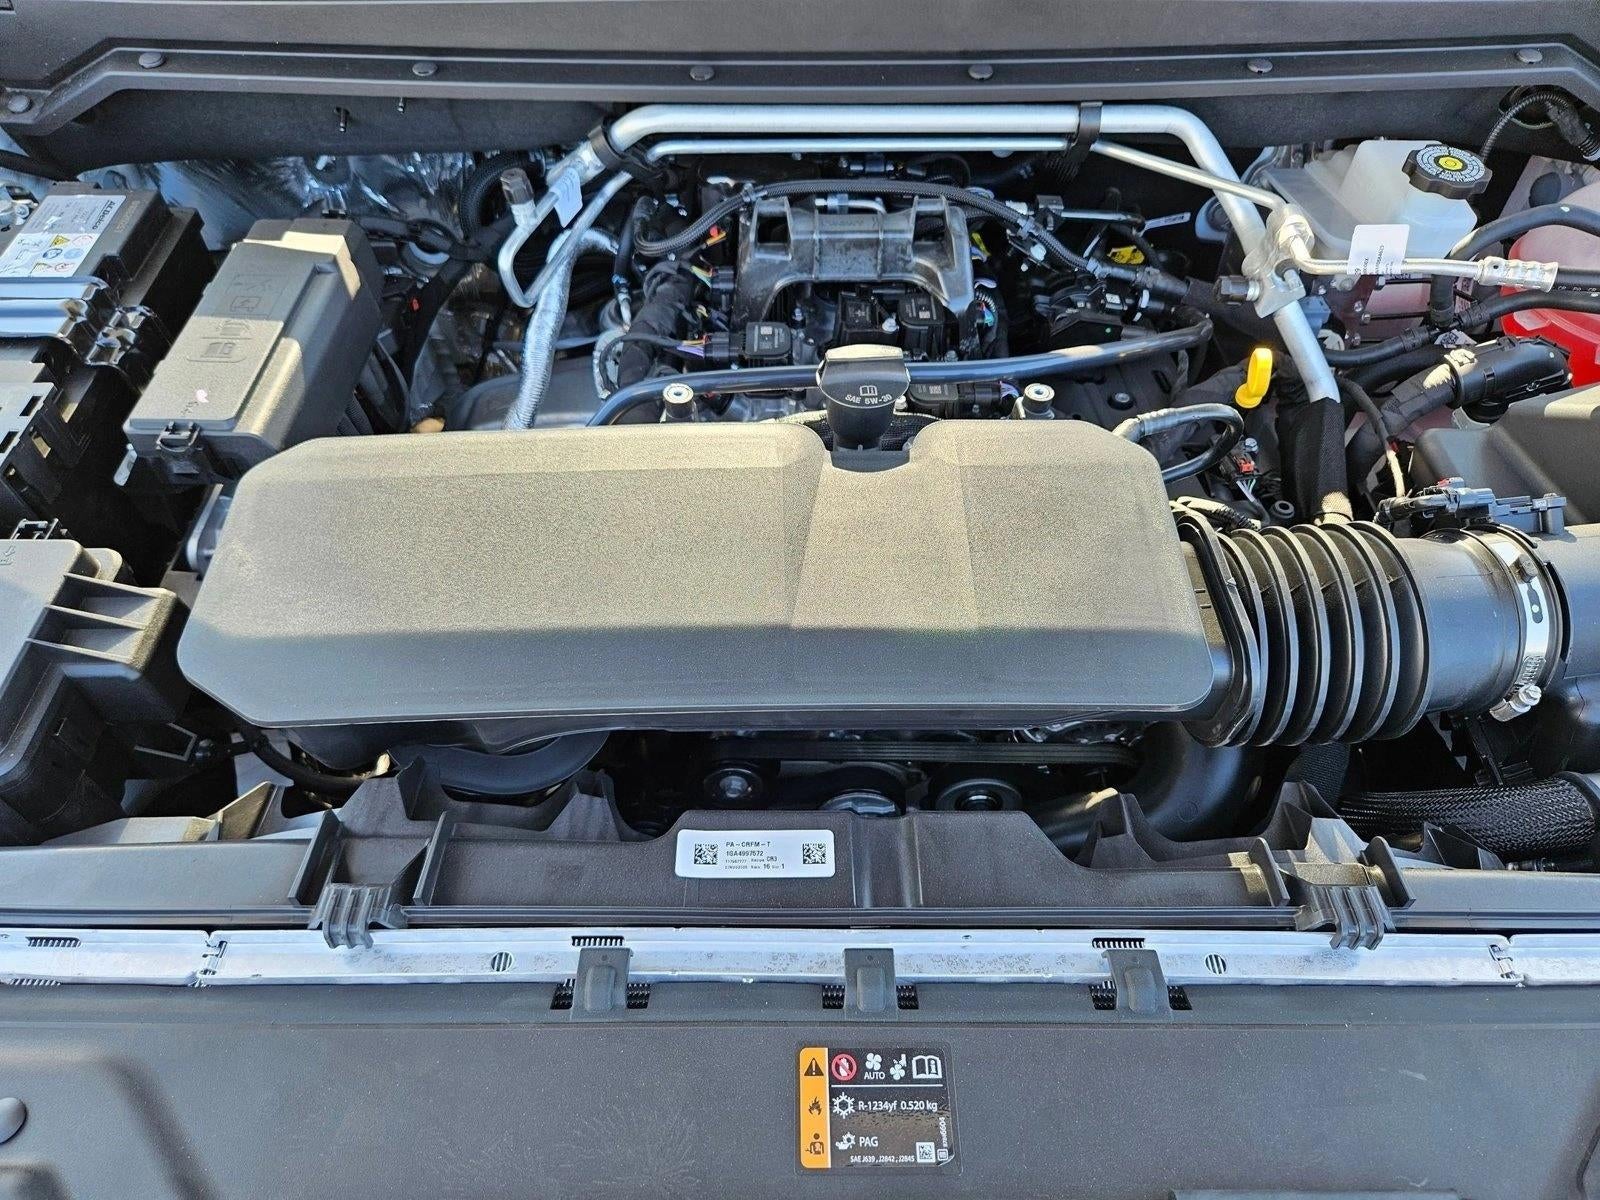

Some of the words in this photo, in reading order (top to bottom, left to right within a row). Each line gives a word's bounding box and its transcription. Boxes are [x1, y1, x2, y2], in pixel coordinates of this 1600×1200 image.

[845, 394, 862, 404] SAE
[864, 394, 893, 405] 5W-30
[864, 1071, 886, 1080] AUTO
[858, 1101, 897, 1112] R-1234yf
[900, 1101, 925, 1110] 0.520
[926, 1101, 938, 1112] kg
[859, 1136, 879, 1147] PAG
[850, 1155, 862, 1163] SAE
